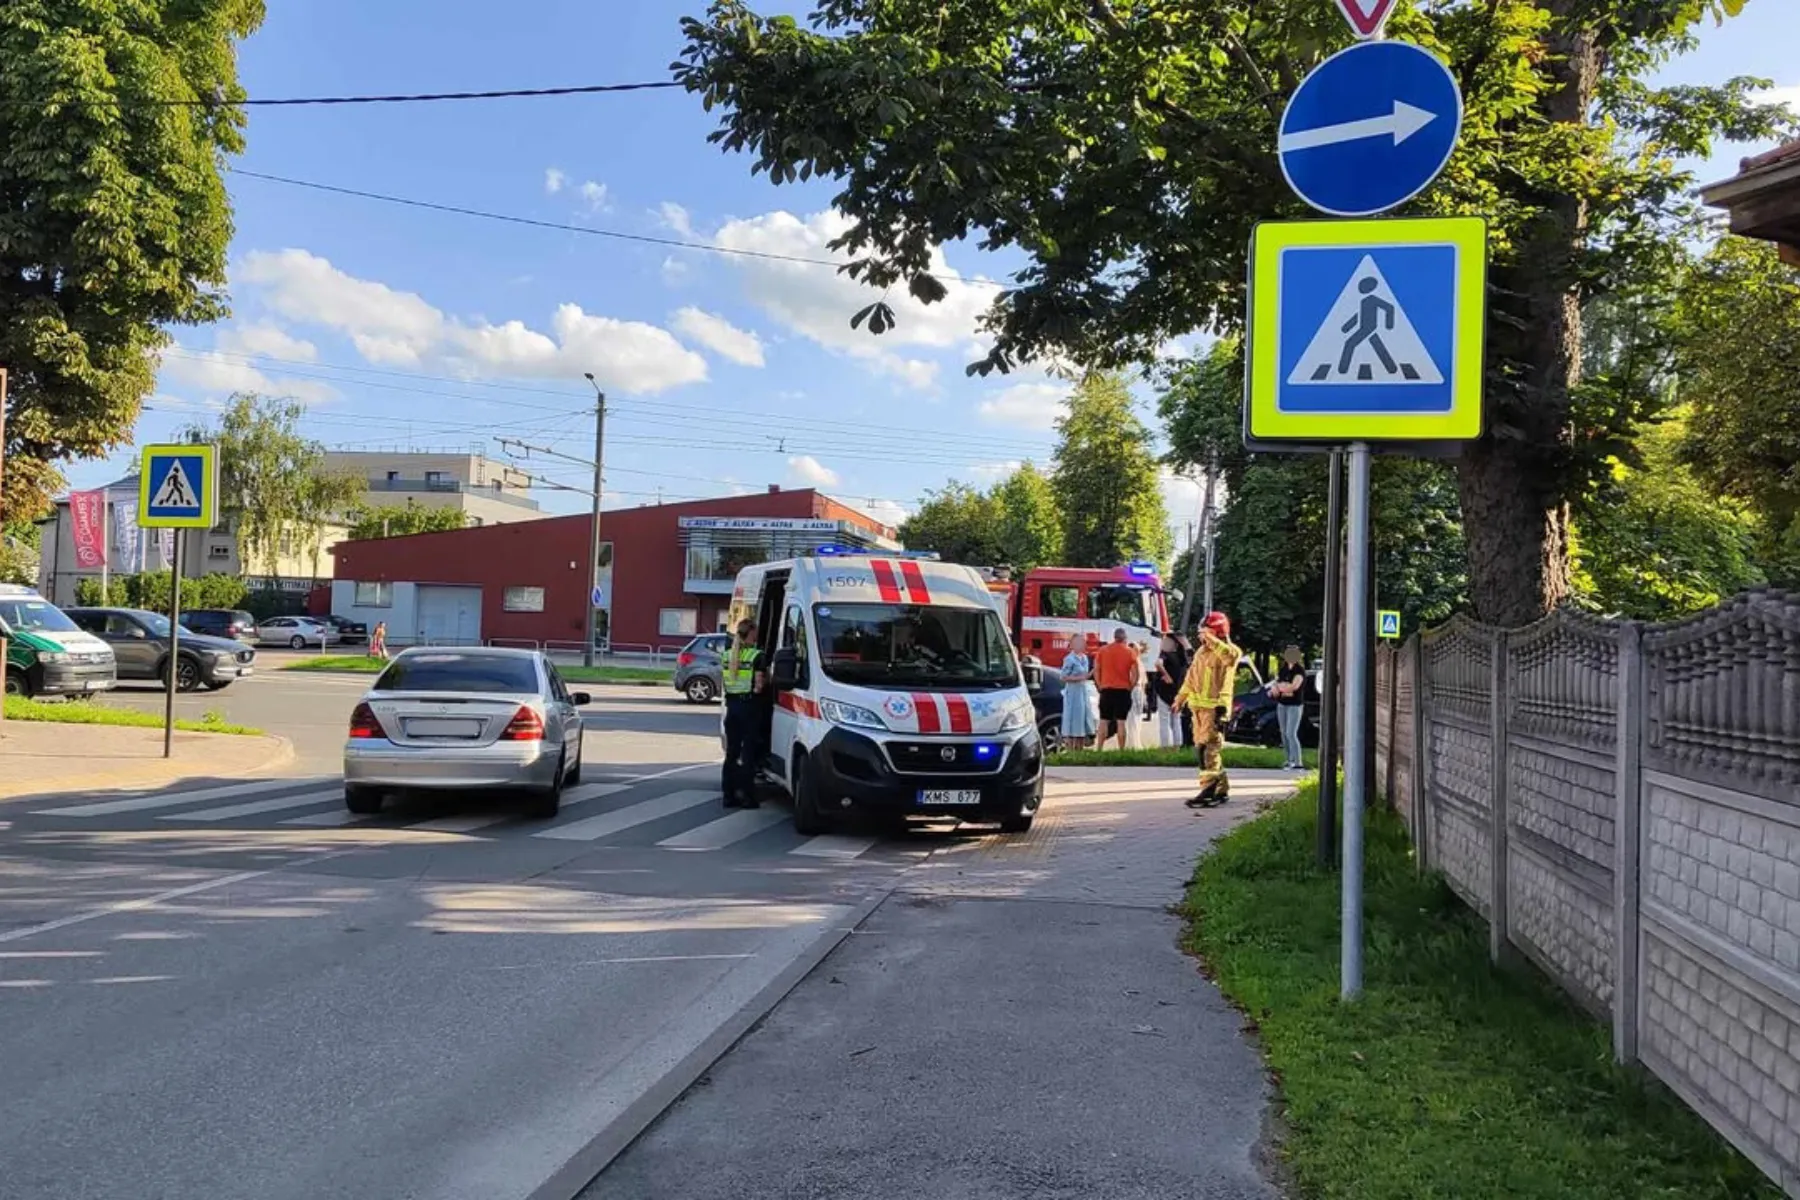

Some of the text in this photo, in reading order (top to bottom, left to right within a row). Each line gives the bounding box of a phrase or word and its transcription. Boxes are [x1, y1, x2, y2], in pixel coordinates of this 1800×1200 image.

[826, 576, 866, 588] 1507
[925, 791, 980, 803] KMS 677
